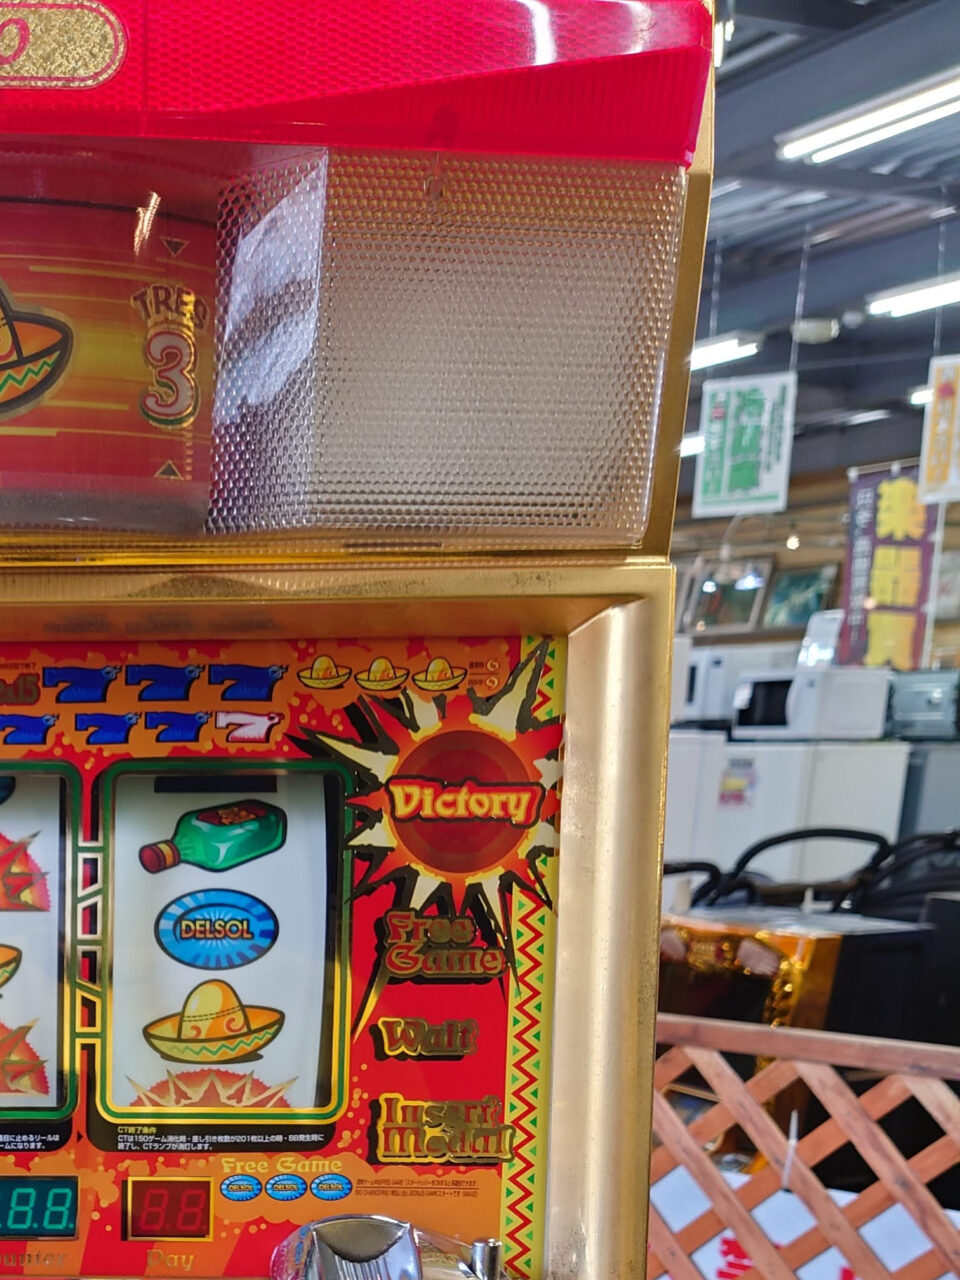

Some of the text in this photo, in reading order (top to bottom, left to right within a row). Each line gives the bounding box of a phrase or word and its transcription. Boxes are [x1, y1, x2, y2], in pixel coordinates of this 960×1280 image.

[131, 285, 209, 331] TRES
[141, 329, 199, 427] 3
[391, 783, 534, 823] Victory
[180, 919, 253, 941] DELSOL
[386, 911, 477, 942] Free
[386, 945, 507, 978] Game
[221, 1157, 342, 1173] Free Game
[147, 1250, 194, 1271] Pay
